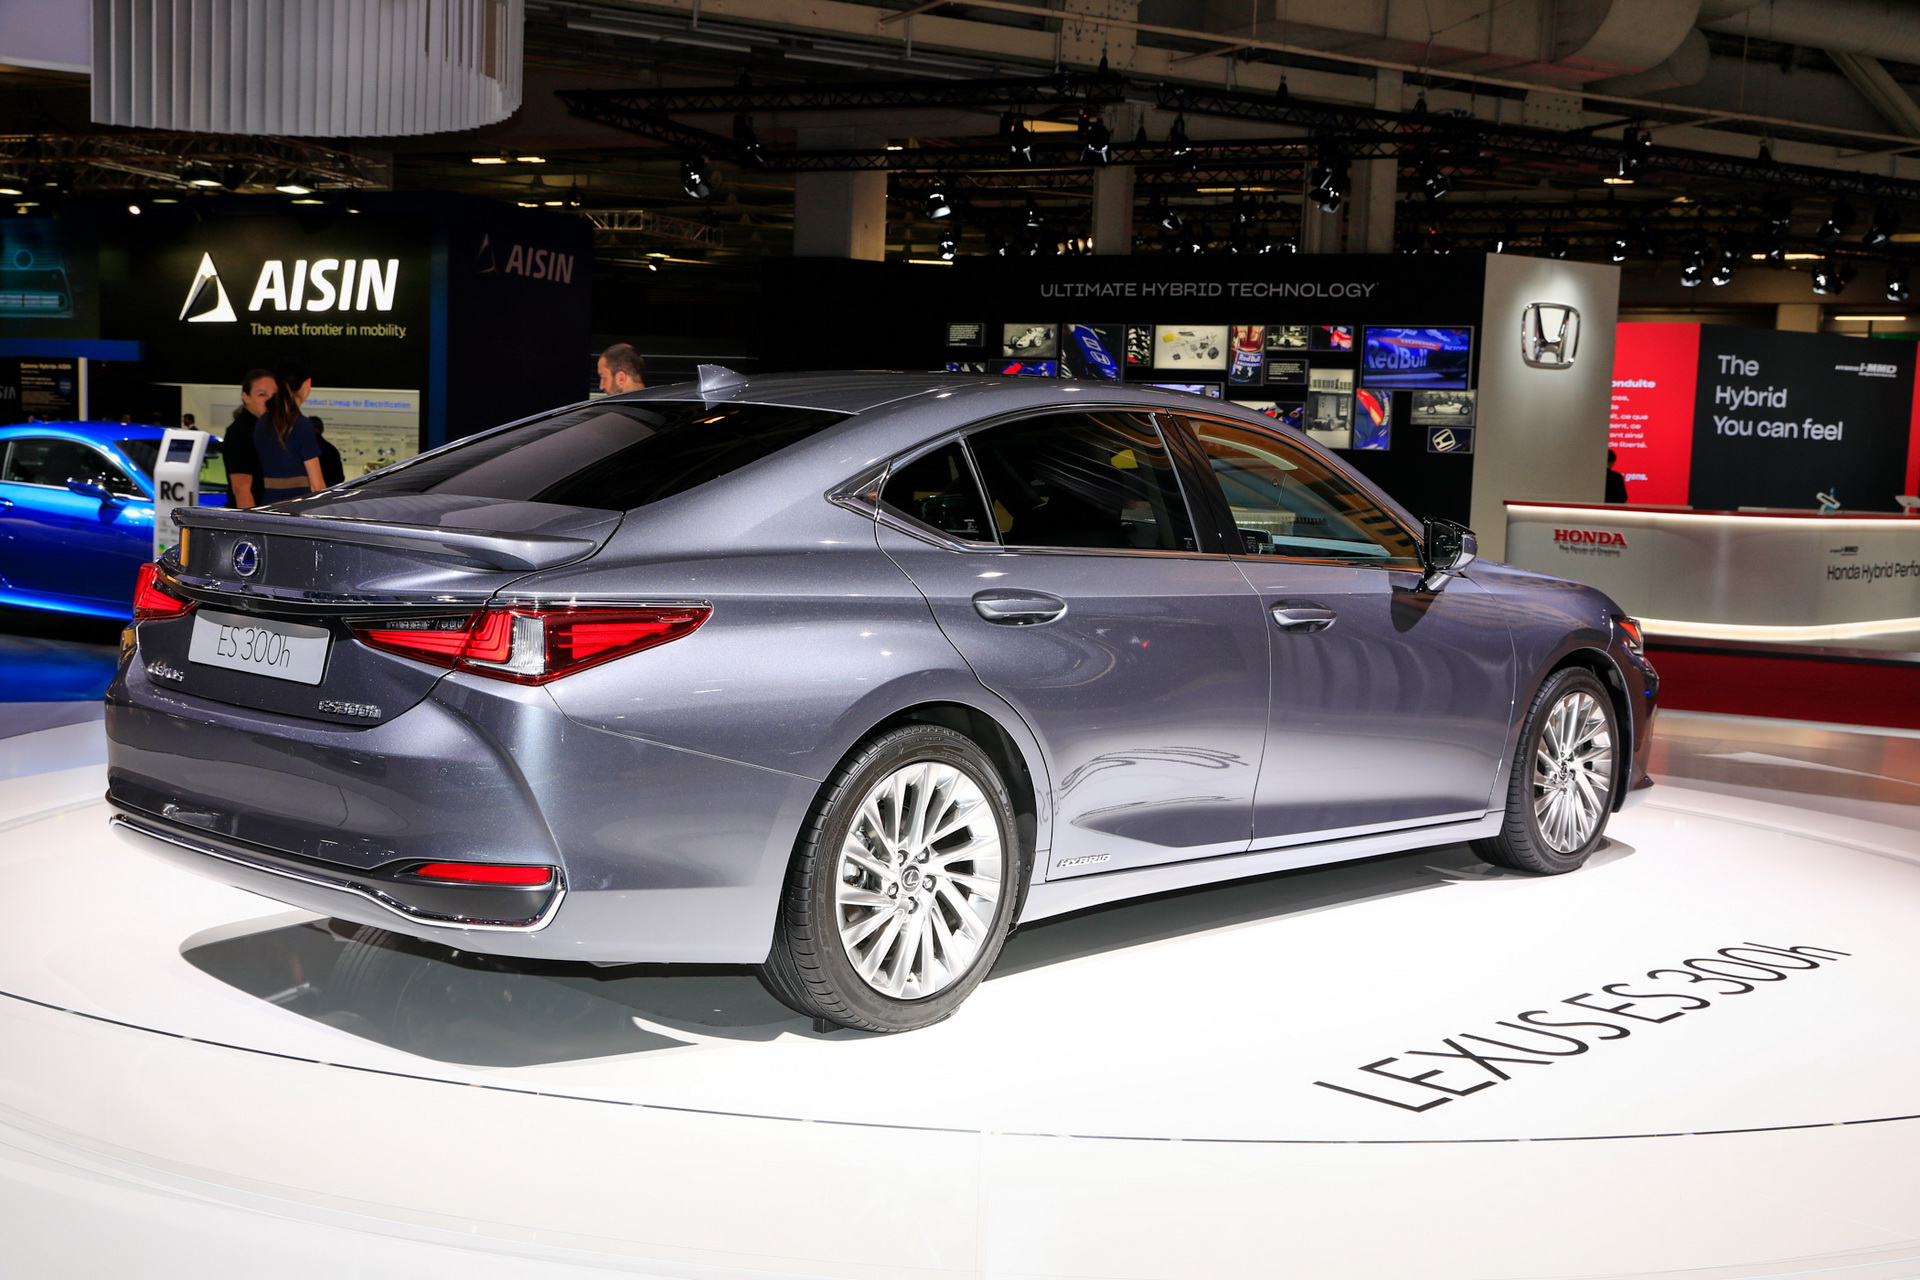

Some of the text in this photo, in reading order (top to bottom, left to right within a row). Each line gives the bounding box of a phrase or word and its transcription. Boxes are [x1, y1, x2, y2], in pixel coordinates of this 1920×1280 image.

[505, 244, 574, 284] AISIN
[248, 258, 399, 312] AISIN
[1040, 282, 1138, 298] ULTIMATE
[1142, 282, 1223, 297] HYBRID
[250, 322, 272, 336] The
[274, 323, 299, 336] next
[301, 322, 343, 336] frontier
[346, 323, 357, 336] in
[1717, 354, 1760, 377] The
[353, 400, 362, 408] for
[364, 400, 411, 409] Electrification
[1714, 384, 1788, 411] Hybrid
[1713, 414, 1844, 441] You can feel
[160, 480, 185, 502] RC
[1553, 529, 1629, 546] HONDA
[1827, 563, 1860, 581] Honda
[1861, 561, 1894, 584] Hybrid
[216, 624, 291, 669] ES 300h
[1056, 853, 1112, 869] HYBRID
[1312, 941, 1853, 1113] LEXUS ES 300h
